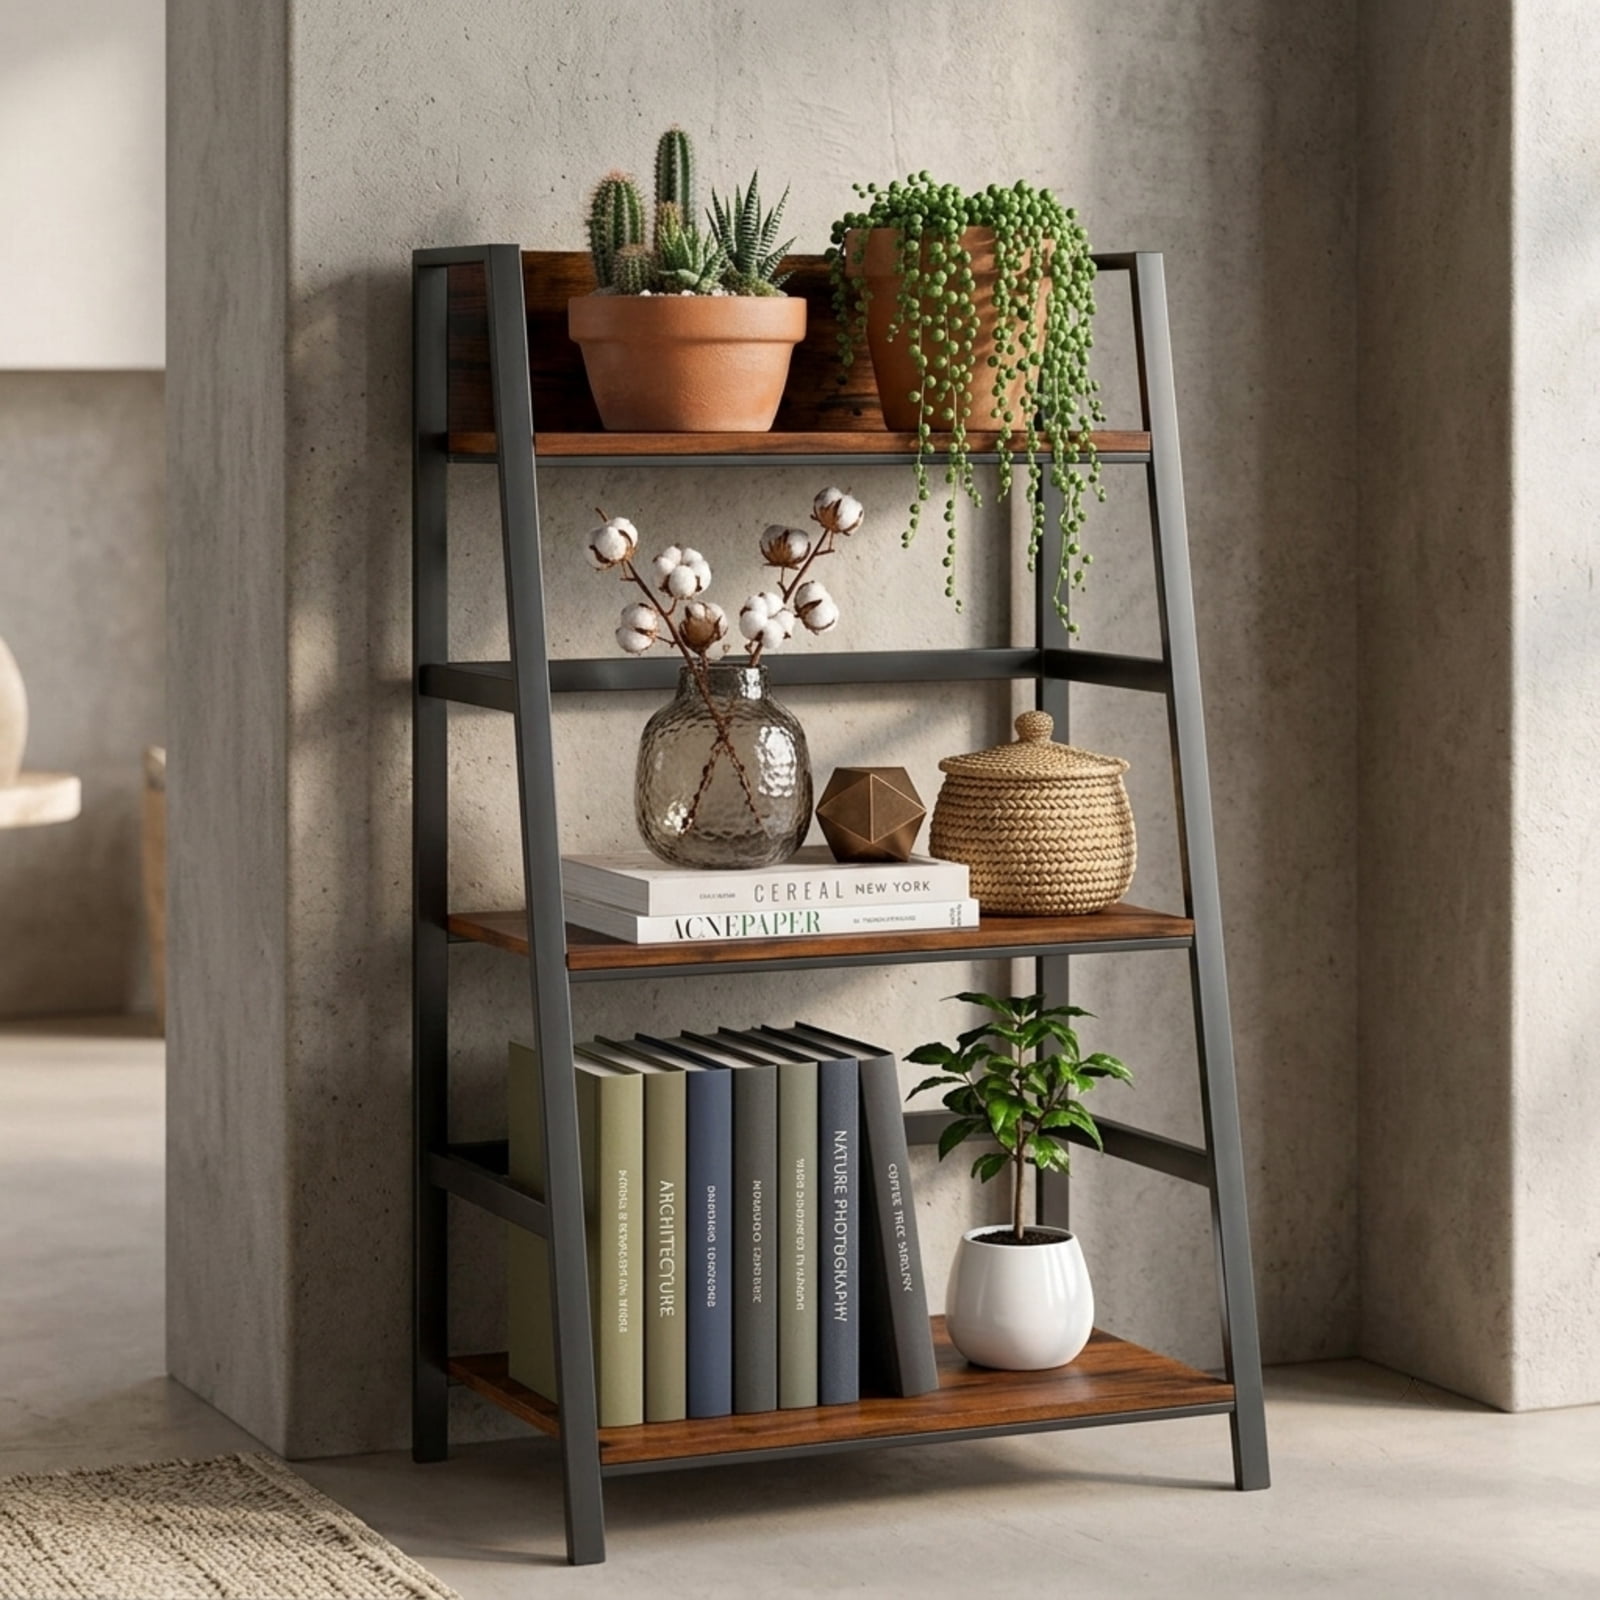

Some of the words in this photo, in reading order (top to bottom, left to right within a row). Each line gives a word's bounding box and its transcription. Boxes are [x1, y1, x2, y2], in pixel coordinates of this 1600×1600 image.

[754, 880, 844, 903] CEREAL
[855, 882, 887, 895] NEW
[893, 880, 931, 893] YORK
[833, 1130, 848, 1195] NATURE
